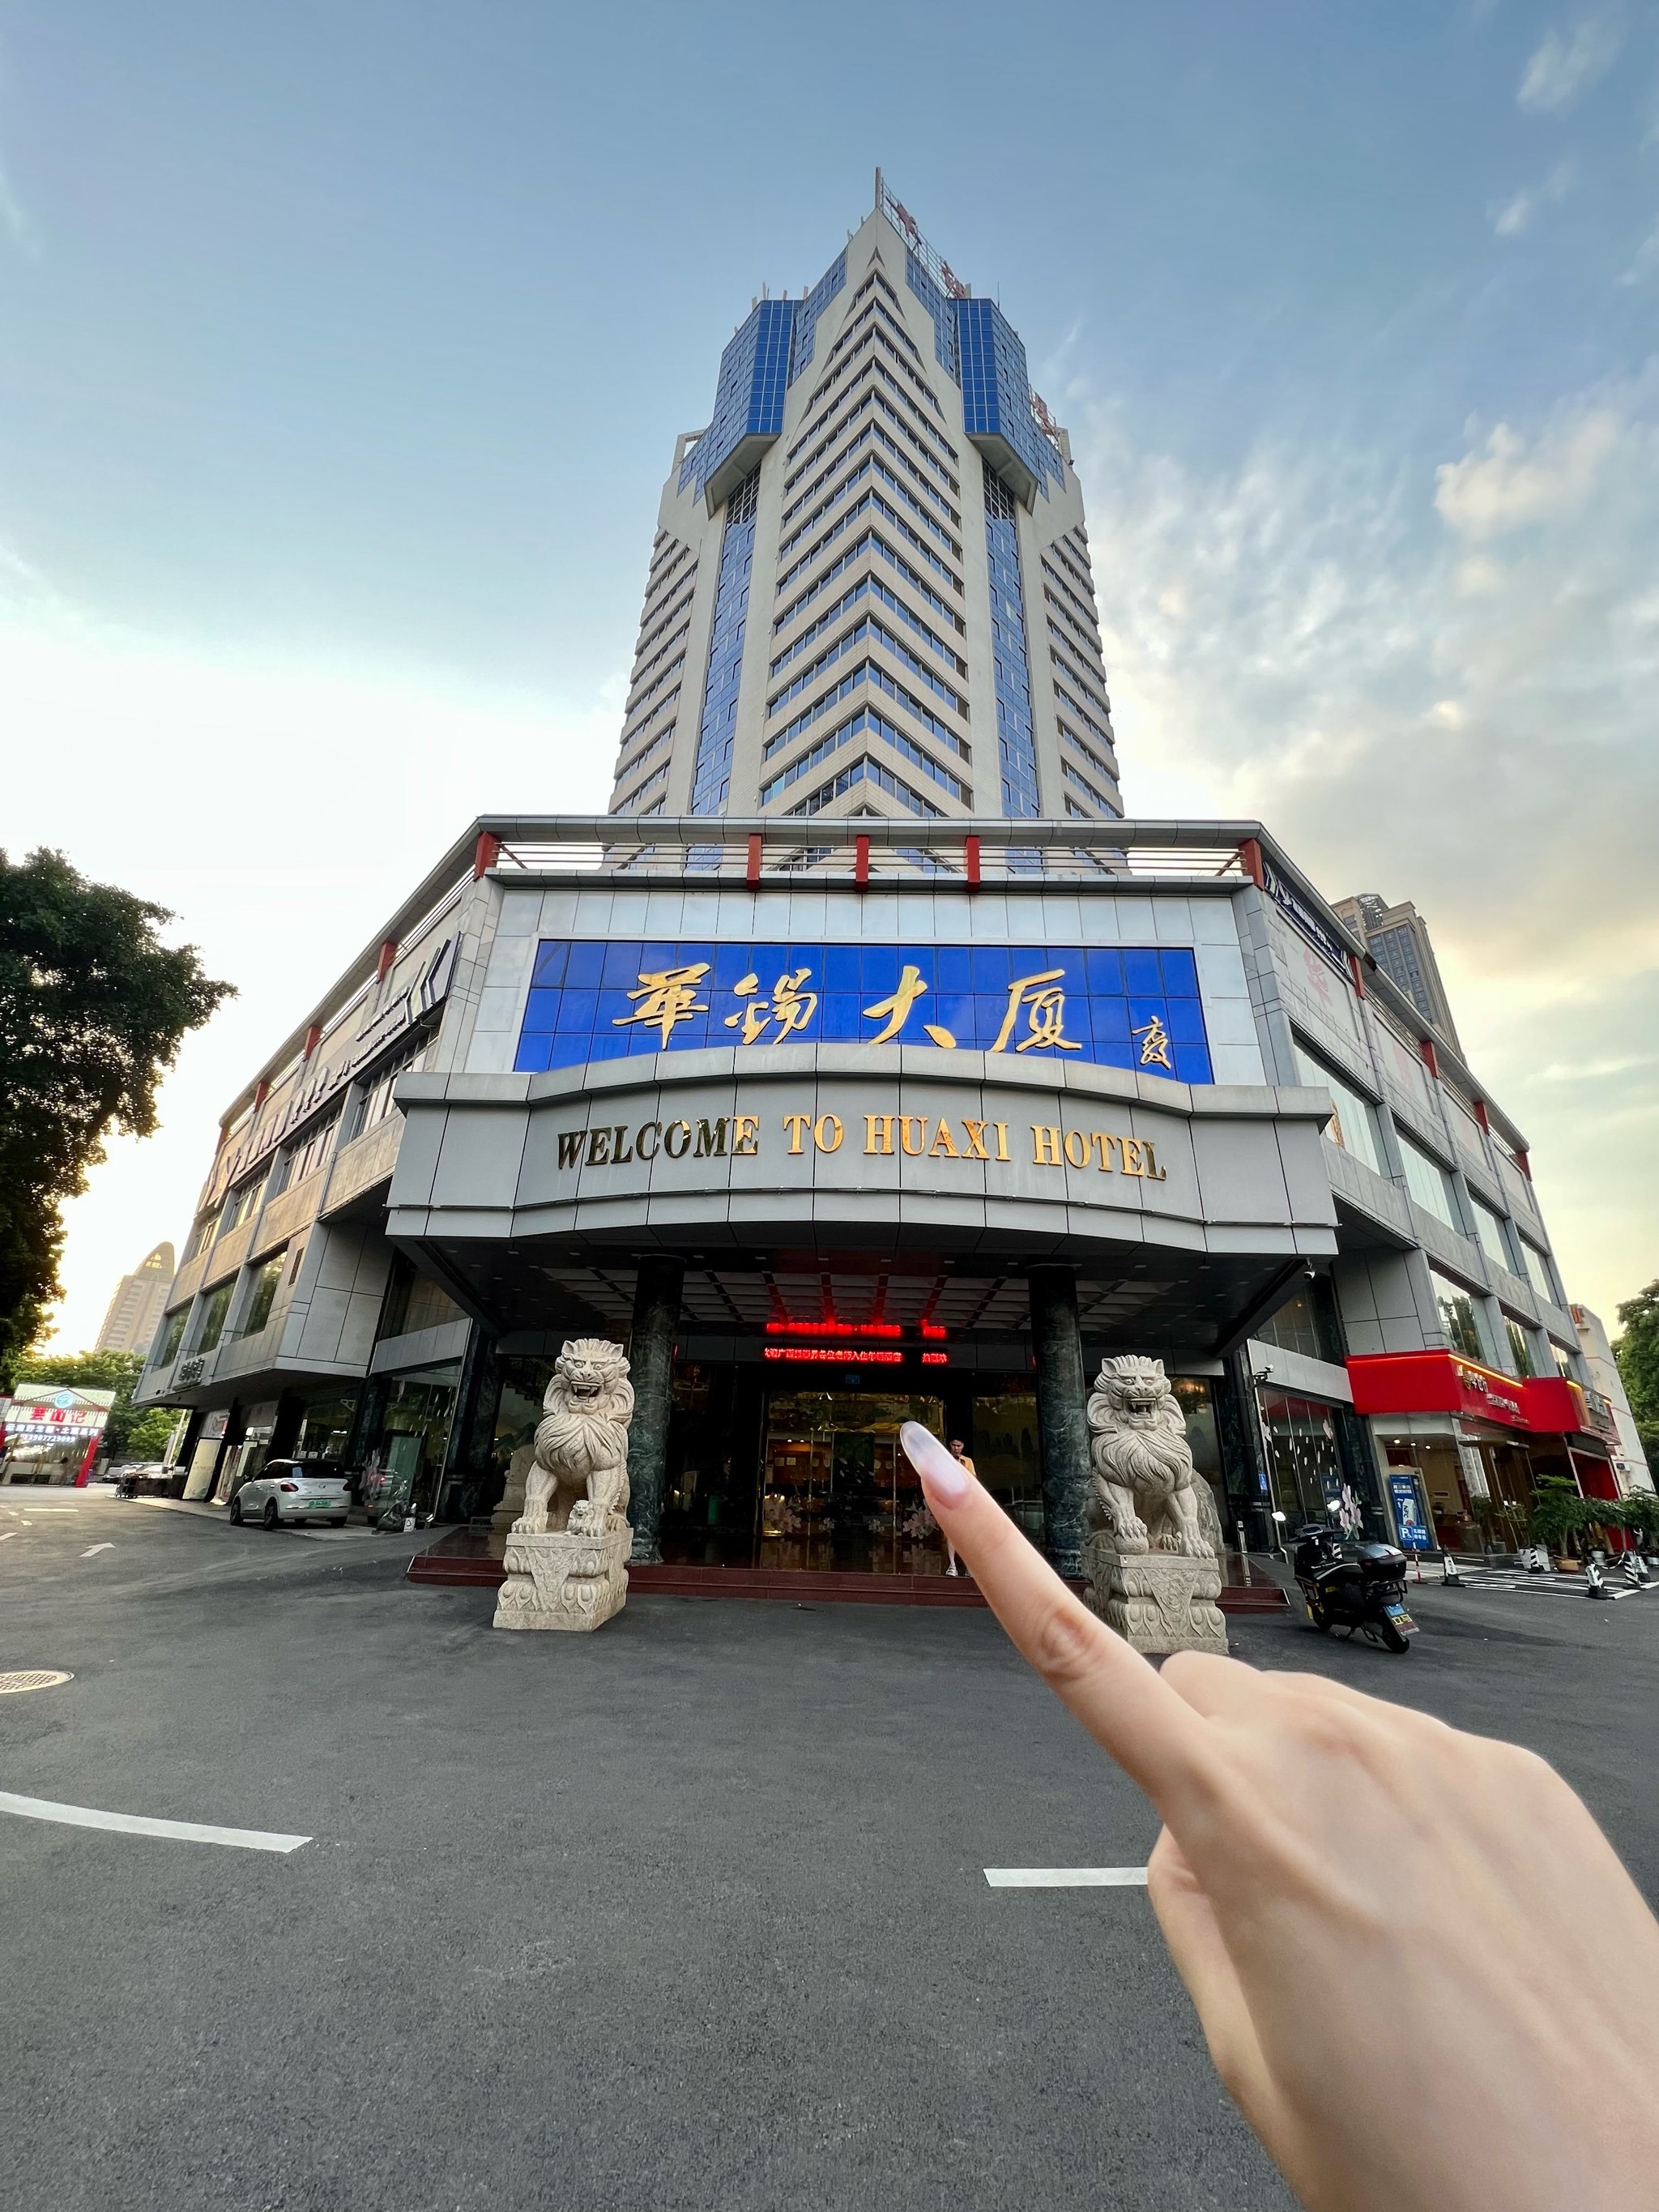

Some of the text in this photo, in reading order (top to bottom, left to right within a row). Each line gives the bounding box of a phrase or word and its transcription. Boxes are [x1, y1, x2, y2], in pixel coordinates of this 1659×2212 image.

[557, 1113, 1167, 1181] WELCOME TO HUAXI HOTEL
